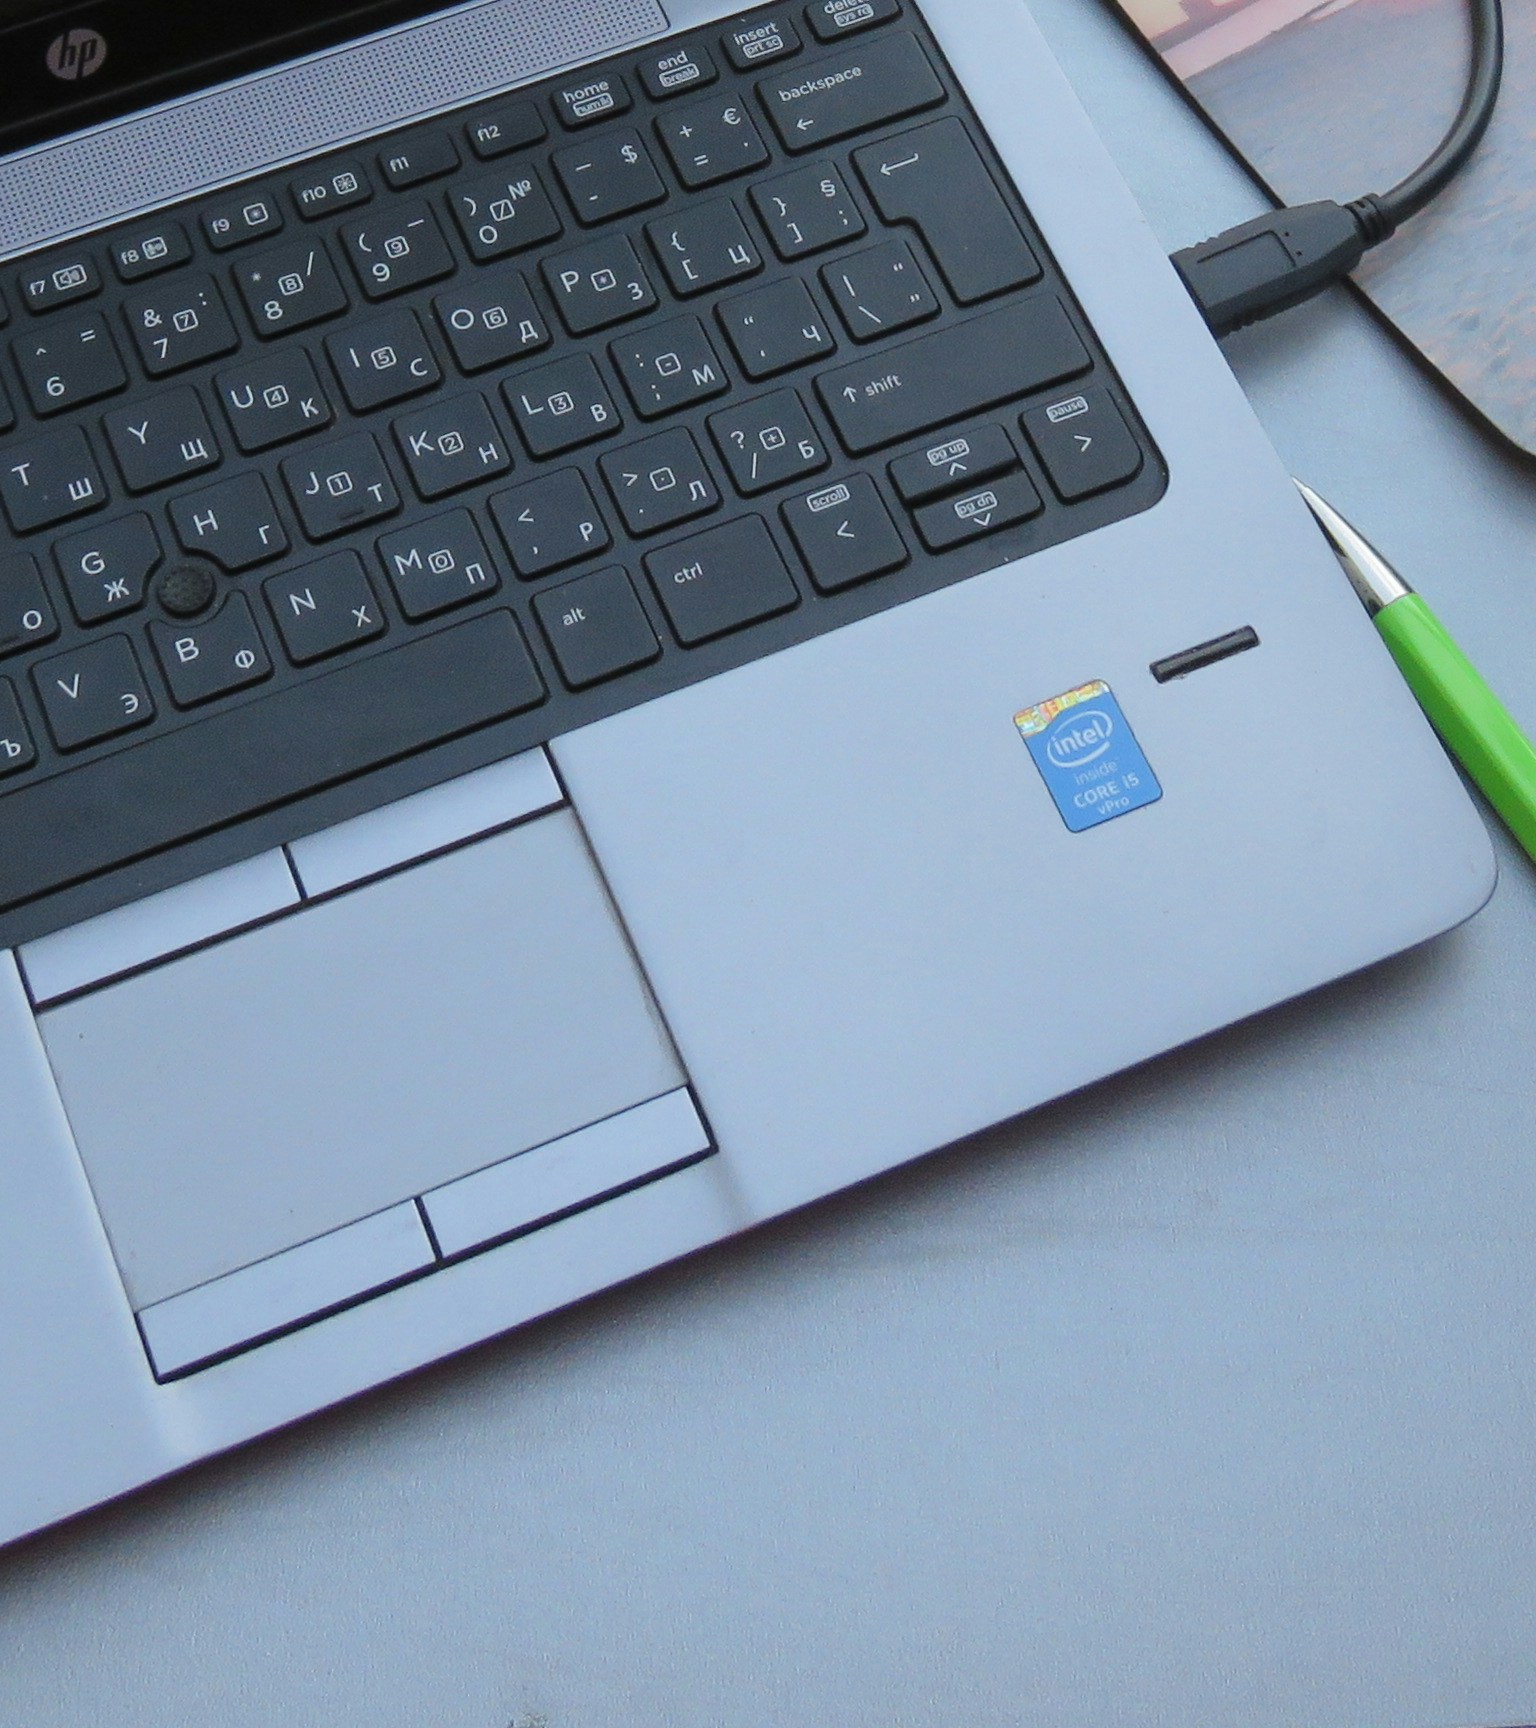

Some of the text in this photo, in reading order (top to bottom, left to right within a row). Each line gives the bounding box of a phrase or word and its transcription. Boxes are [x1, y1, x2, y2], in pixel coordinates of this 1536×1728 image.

[733, 22, 779, 45] insert
[54, 29, 101, 79] hp
[657, 50, 688, 70] end
[663, 65, 696, 84] break
[779, 67, 862, 101] backspace
[563, 80, 610, 103] home
[478, 125, 501, 141] f12
[390, 157, 409, 172] f11
[621, 145, 640, 163] $
[300, 186, 326, 203] f10
[212, 219, 231, 234] f9
[121, 250, 139, 265] f8
[372, 263, 390, 282] 9
[560, 271, 579, 292] P
[29, 280, 45, 296] f7
[144, 309, 162, 327] &
[264, 300, 283, 320] 8
[153, 338, 167, 361] 7
[47, 376, 65, 396] 6
[865, 375, 901, 396] shift
[231, 385, 253, 408] U
[519, 395, 544, 415] L
[1049, 398, 1085, 420] pause
[127, 421, 148, 444] Y
[409, 431, 435, 456] K
[11, 463, 30, 485] T
[306, 471, 319, 494] J
[812, 487, 846, 508] scroll
[193, 510, 218, 535] H
[81, 551, 105, 574] G
[394, 549, 423, 575] M
[674, 562, 703, 583] ctrl
[289, 588, 316, 616] N
[563, 608, 586, 625] alt
[175, 637, 199, 662] B
[57, 674, 79, 698] V
[1051, 718, 1106, 756] intel
[1074, 760, 1118, 786] inside
[1073, 780, 1120, 808] CORE
[1096, 796, 1131, 815] vPro
